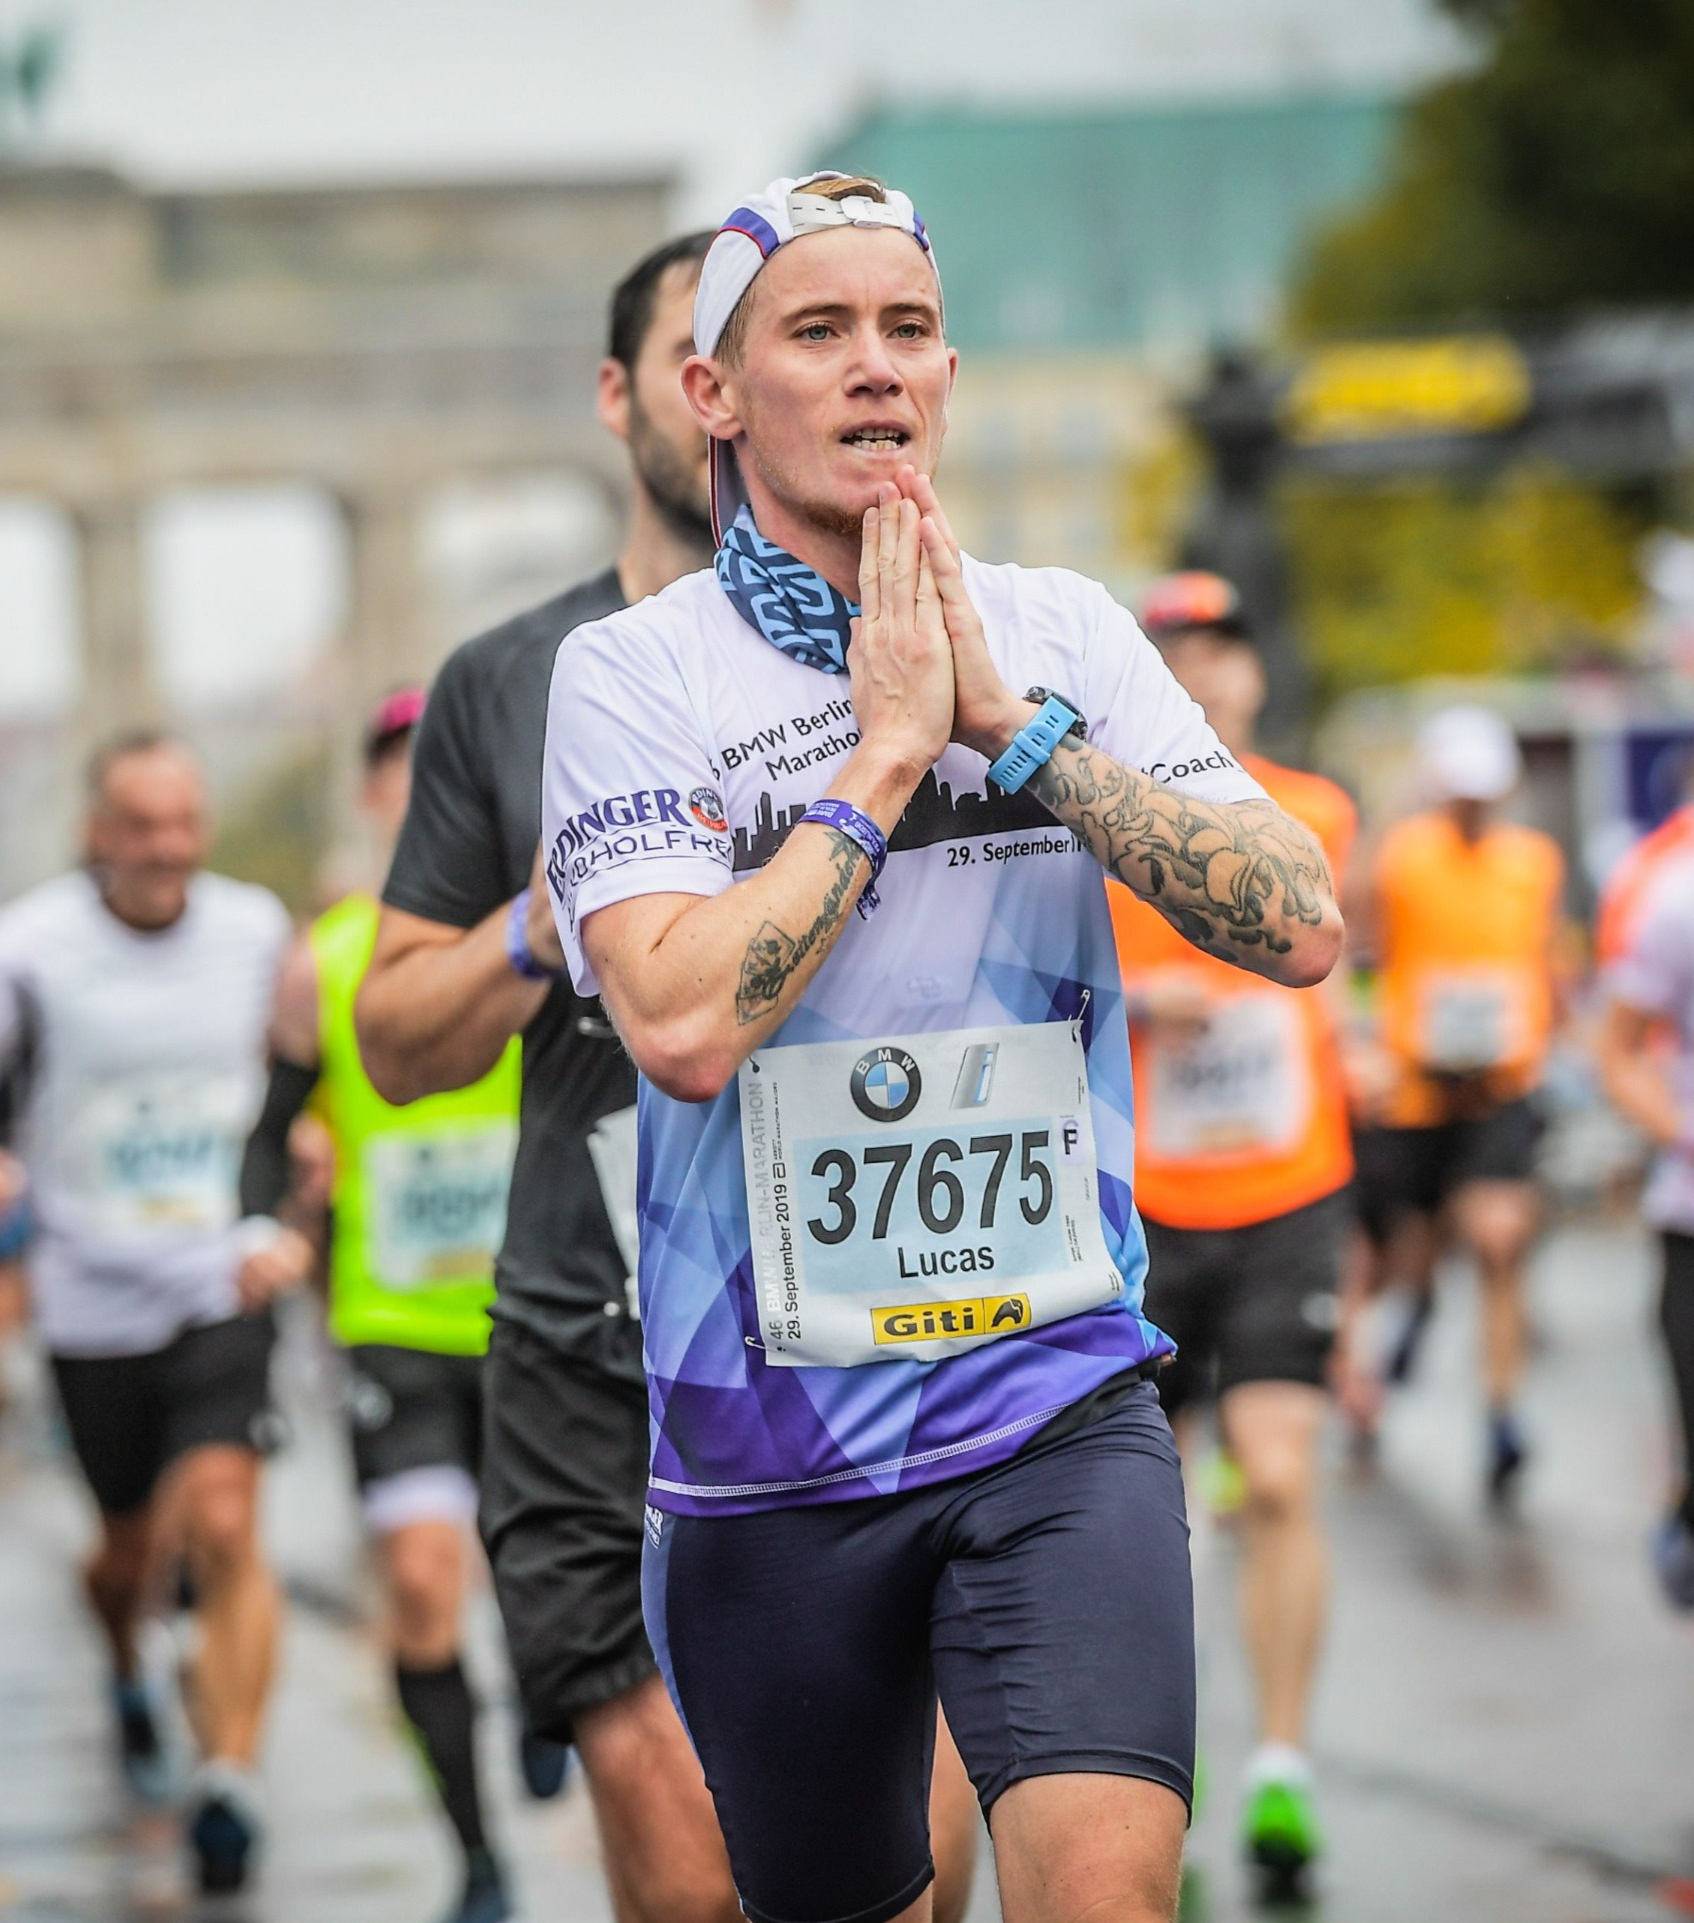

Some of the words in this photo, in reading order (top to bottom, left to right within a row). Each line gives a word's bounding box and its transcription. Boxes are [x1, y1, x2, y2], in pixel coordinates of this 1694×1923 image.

[721, 724, 788, 770] BMW
[791, 699, 852, 736] Berlin
[765, 727, 863, 781] Maratho
[1141, 750, 1235, 784] Coach
[546, 788, 692, 904] ERDINGER
[947, 845, 976, 868] 29.
[856, 1049, 915, 1075] BMW
[773, 1184, 790, 1222] 2019
[807, 1130, 1053, 1245] 37675
[779, 1225, 799, 1312] September
[897, 1246, 995, 1279] Lucas
[763, 1264, 783, 1312] BMW
[787, 1315, 802, 1340] 29.
[884, 1307, 974, 1336] Giti
